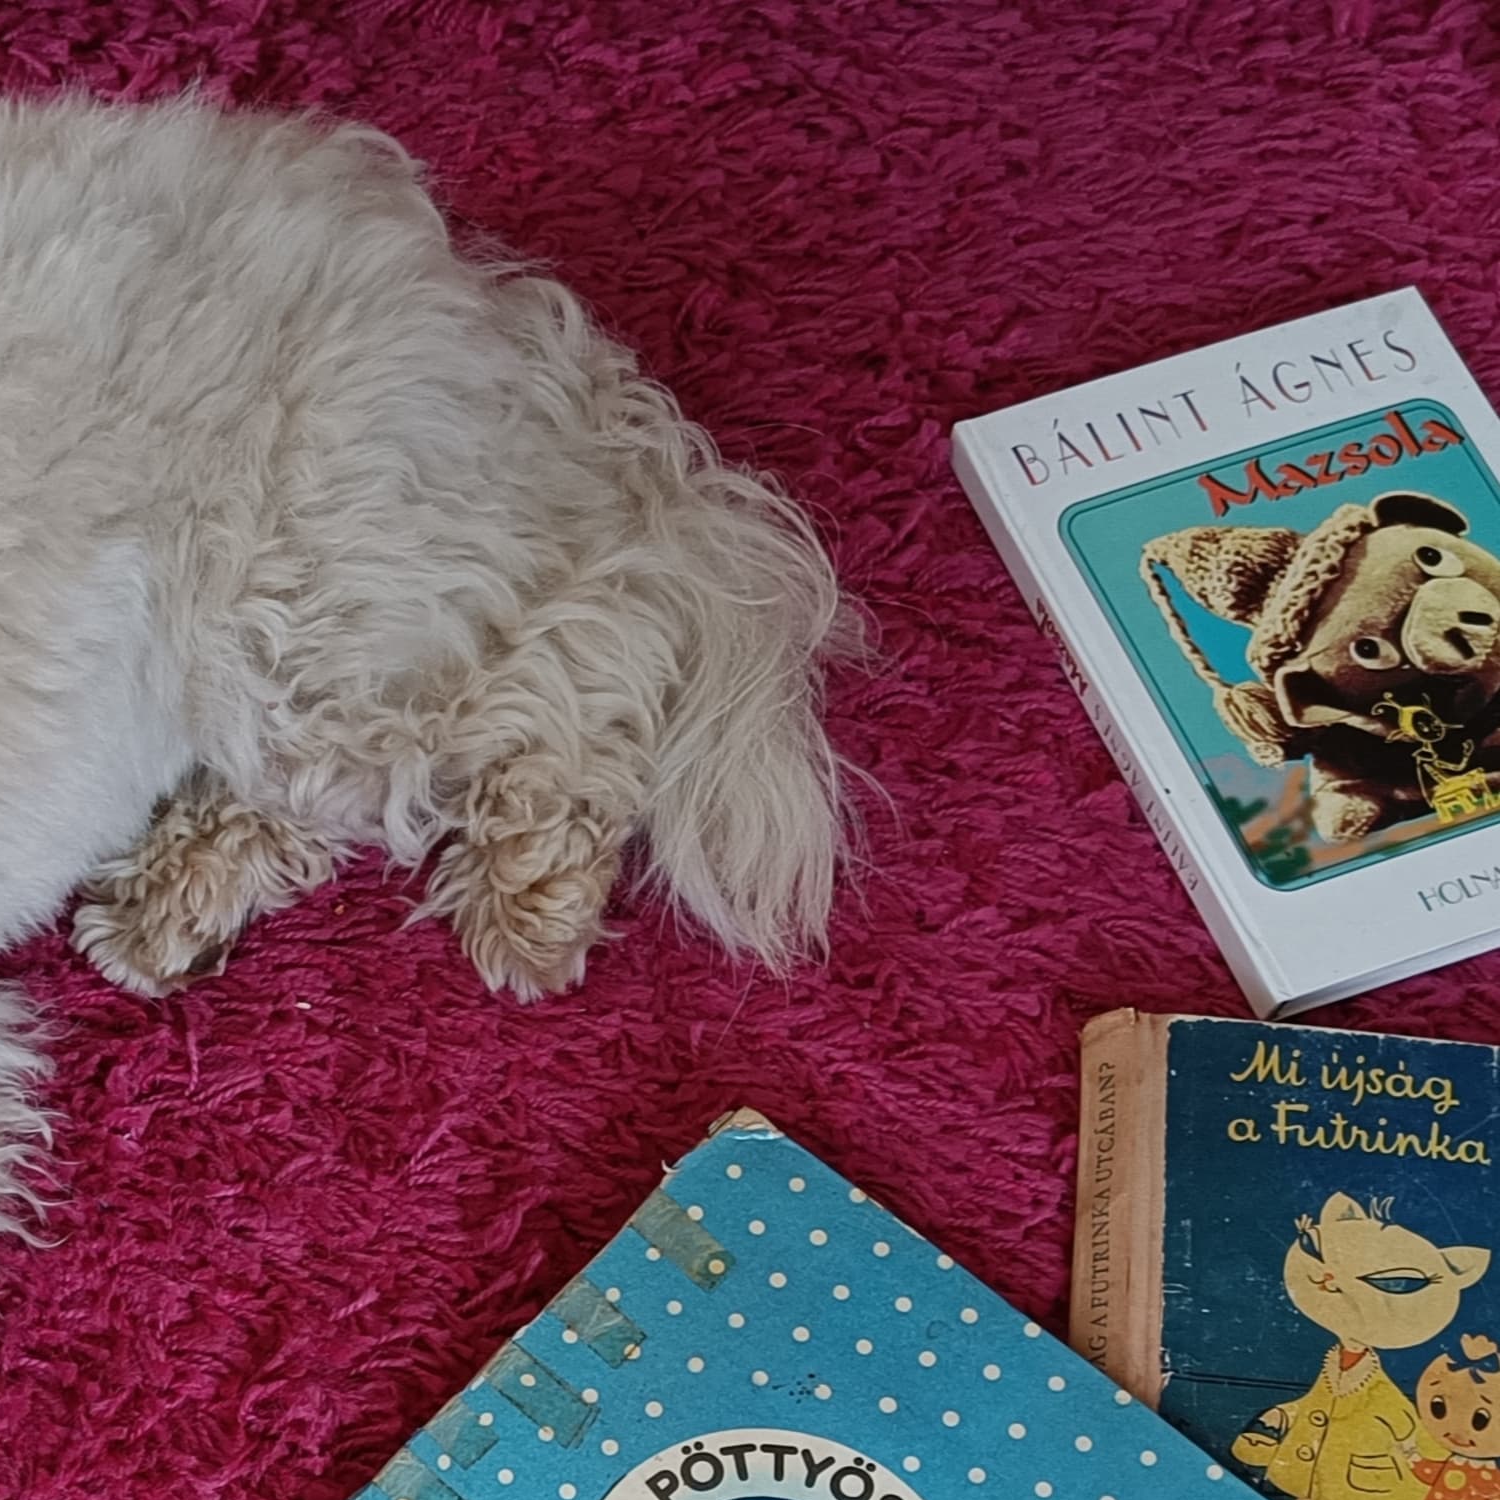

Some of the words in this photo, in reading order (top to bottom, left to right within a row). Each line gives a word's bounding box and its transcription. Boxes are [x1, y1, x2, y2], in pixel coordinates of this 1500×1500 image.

[1011, 391, 1211, 486] BÁLINT
[1239, 328, 1419, 412] ÁGNES
[1197, 409, 1466, 516] Mazsola
[1094, 1062, 1117, 1185] UTCÁBAN?
[1226, 1118, 1261, 1144] a
[1271, 1101, 1491, 1166] Futrinka
[1230, 1041, 1306, 1089] Mi
[1320, 1051, 1461, 1112] újság
[1089, 1187, 1111, 1311] FUTRINKA
